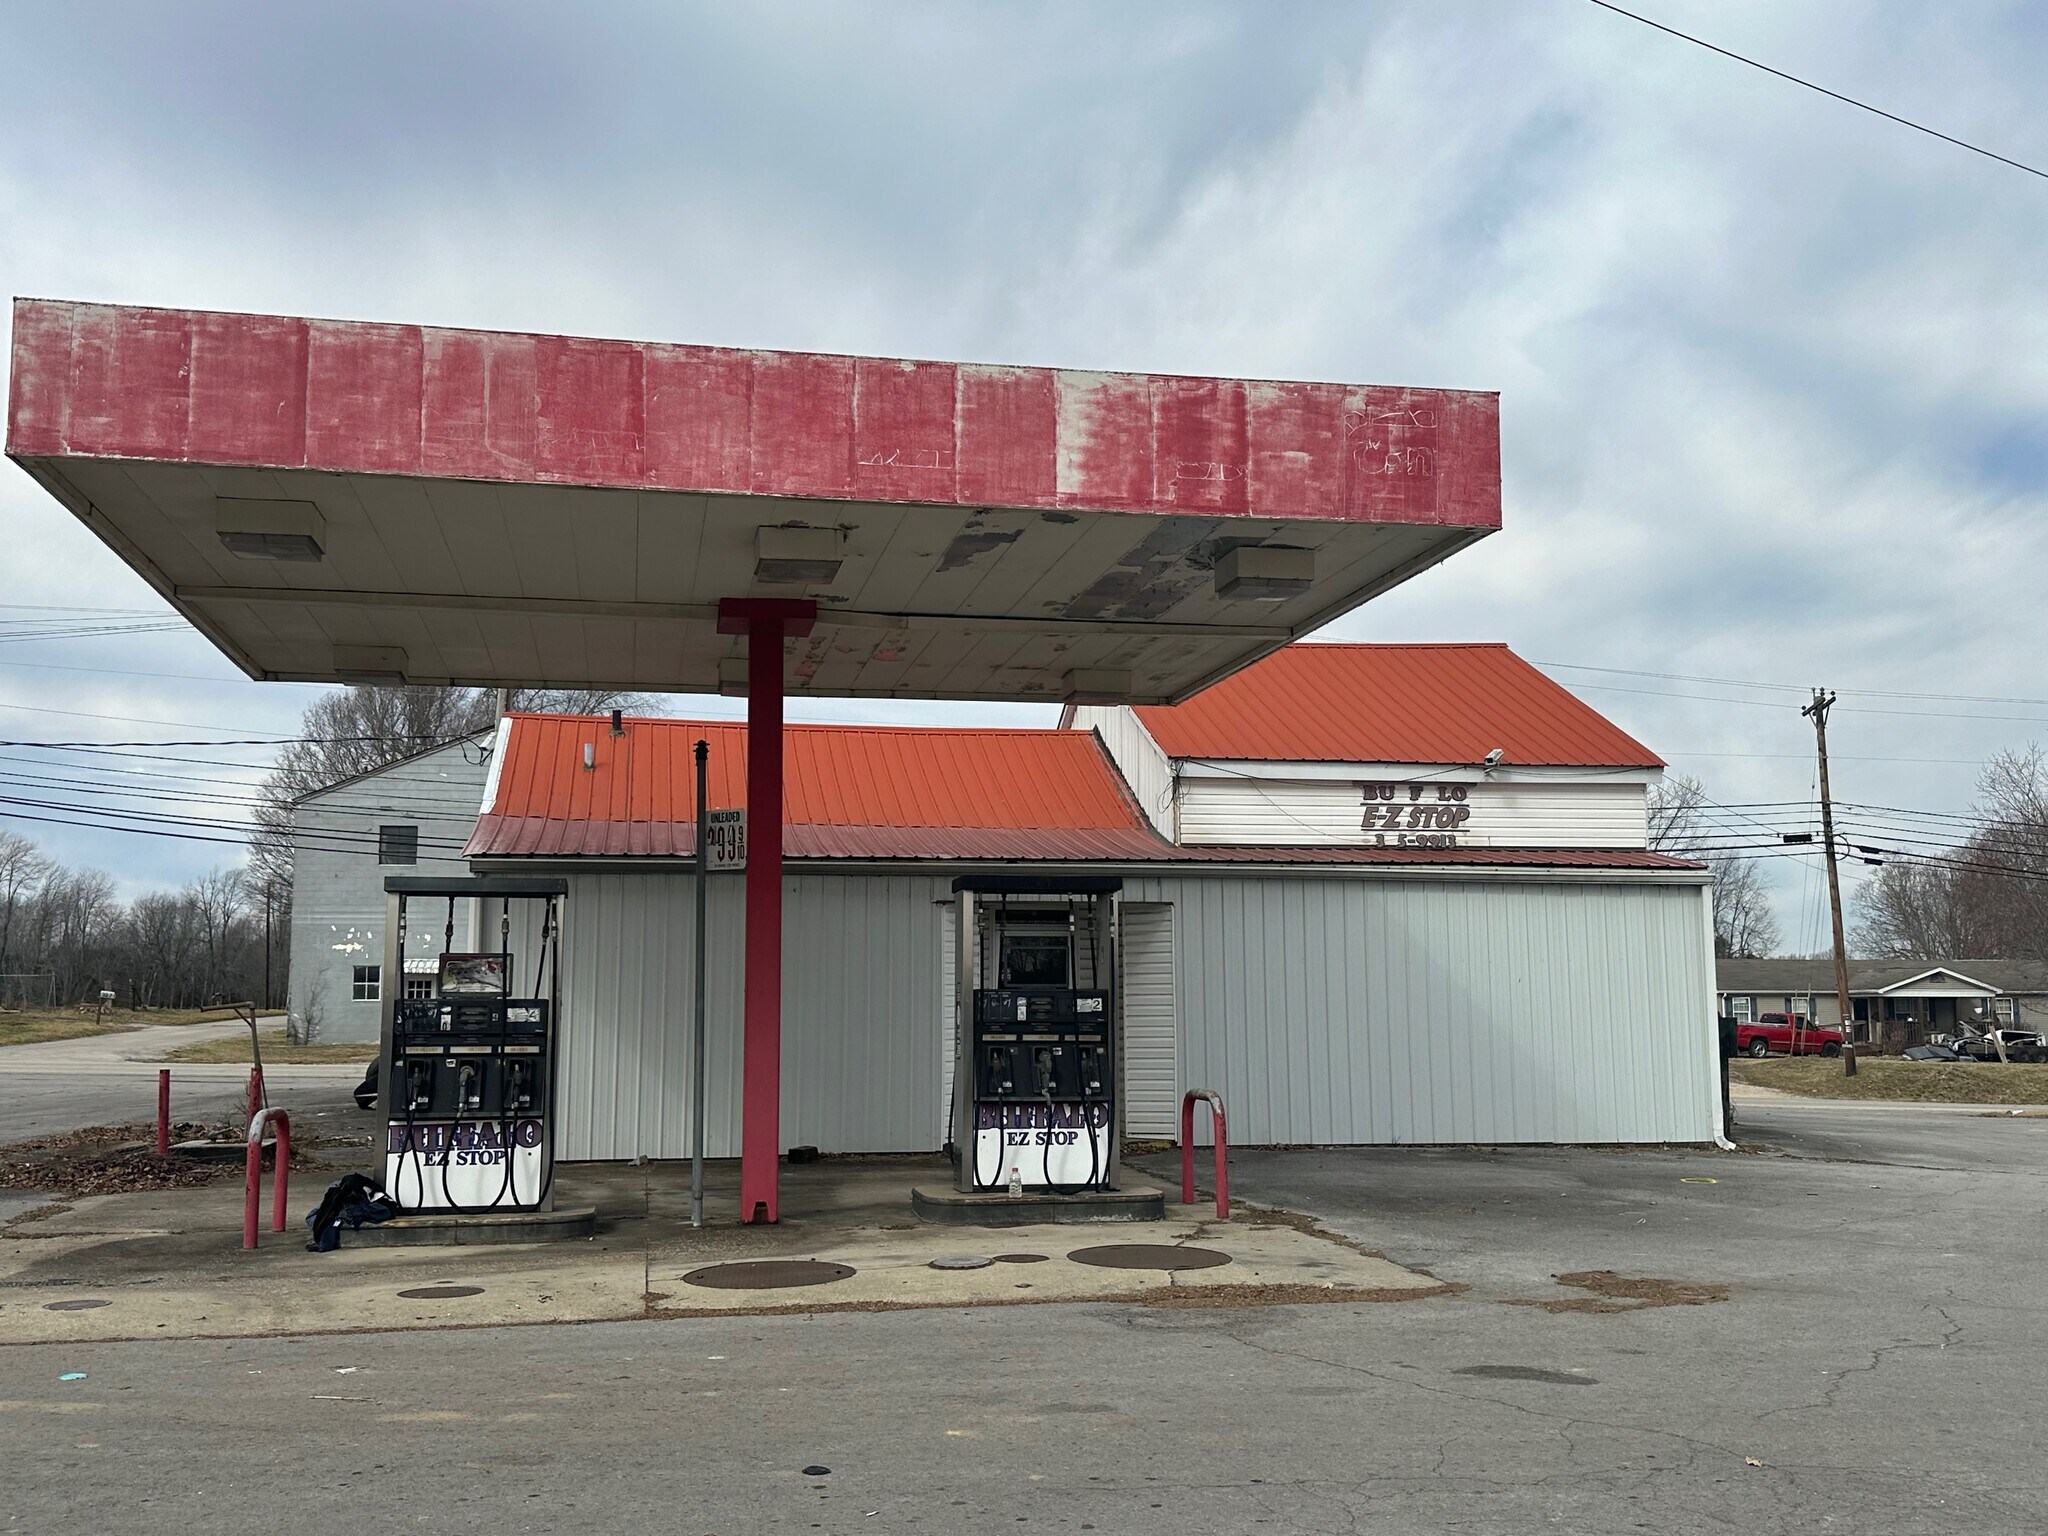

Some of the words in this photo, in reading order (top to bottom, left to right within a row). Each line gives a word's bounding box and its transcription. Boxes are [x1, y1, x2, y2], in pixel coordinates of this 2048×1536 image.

[711, 811, 740, 823] UNLEADED
[1361, 806, 1404, 828] E-Z
[1407, 807, 1470, 828] STOP
[1093, 999, 1100, 1010] 2
[1007, 1132, 1030, 1146] EZ
[1036, 1132, 1078, 1146] STOP
[424, 1151, 449, 1167] EZ
[457, 1151, 506, 1166] STOP
